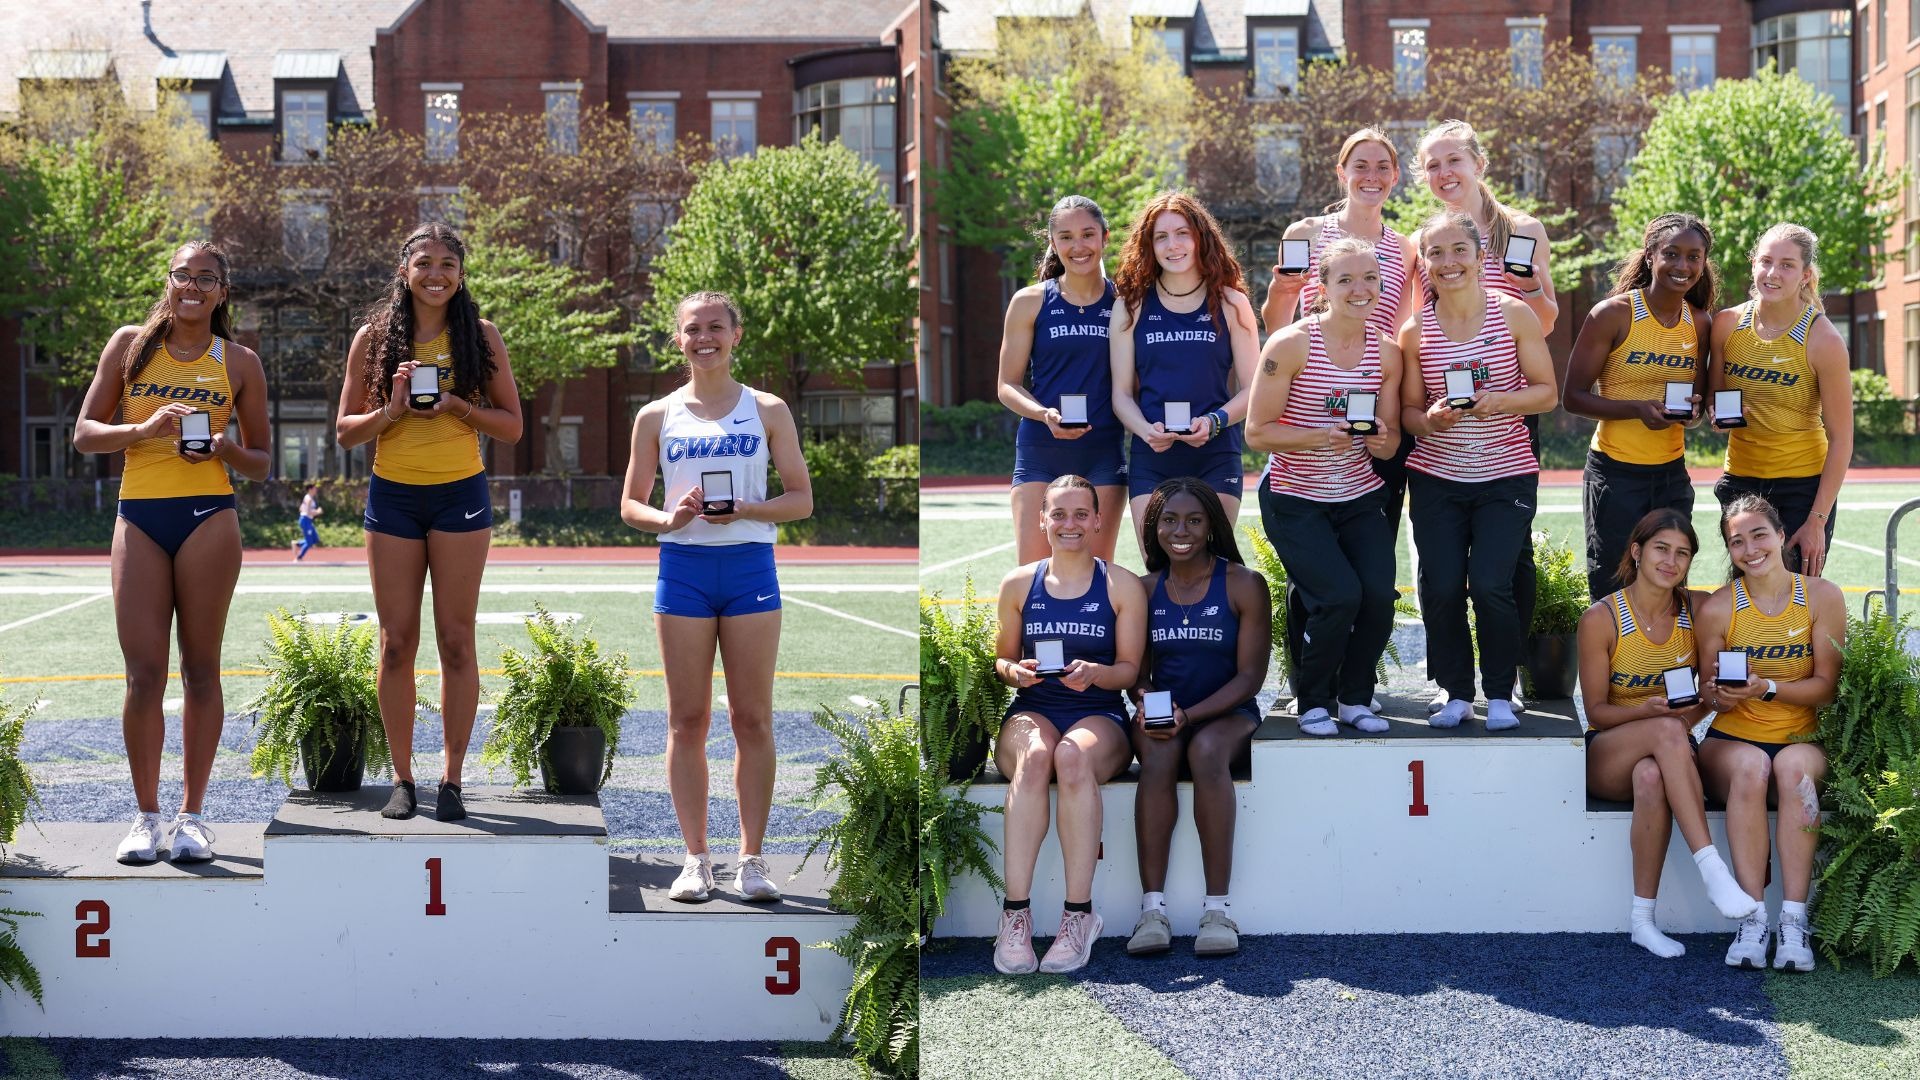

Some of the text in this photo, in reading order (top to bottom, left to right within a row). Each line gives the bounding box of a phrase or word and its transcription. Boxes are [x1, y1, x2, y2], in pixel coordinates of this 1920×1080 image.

[1049, 324, 1110, 339] BRANDEI
[1145, 330, 1217, 345] BRANDEIS
[1625, 351, 1697, 370] EMOR
[129, 382, 228, 407] EMORY
[1324, 396, 1347, 409] WA
[666, 433, 762, 463] CWRU
[1026, 621, 1106, 638] BRANDEIS
[1152, 627, 1223, 643] BRANDEIS
[1408, 760, 1428, 816] 1
[425, 857, 446, 916] 1
[75, 900, 111, 958] 2
[765, 936, 801, 995] 3
